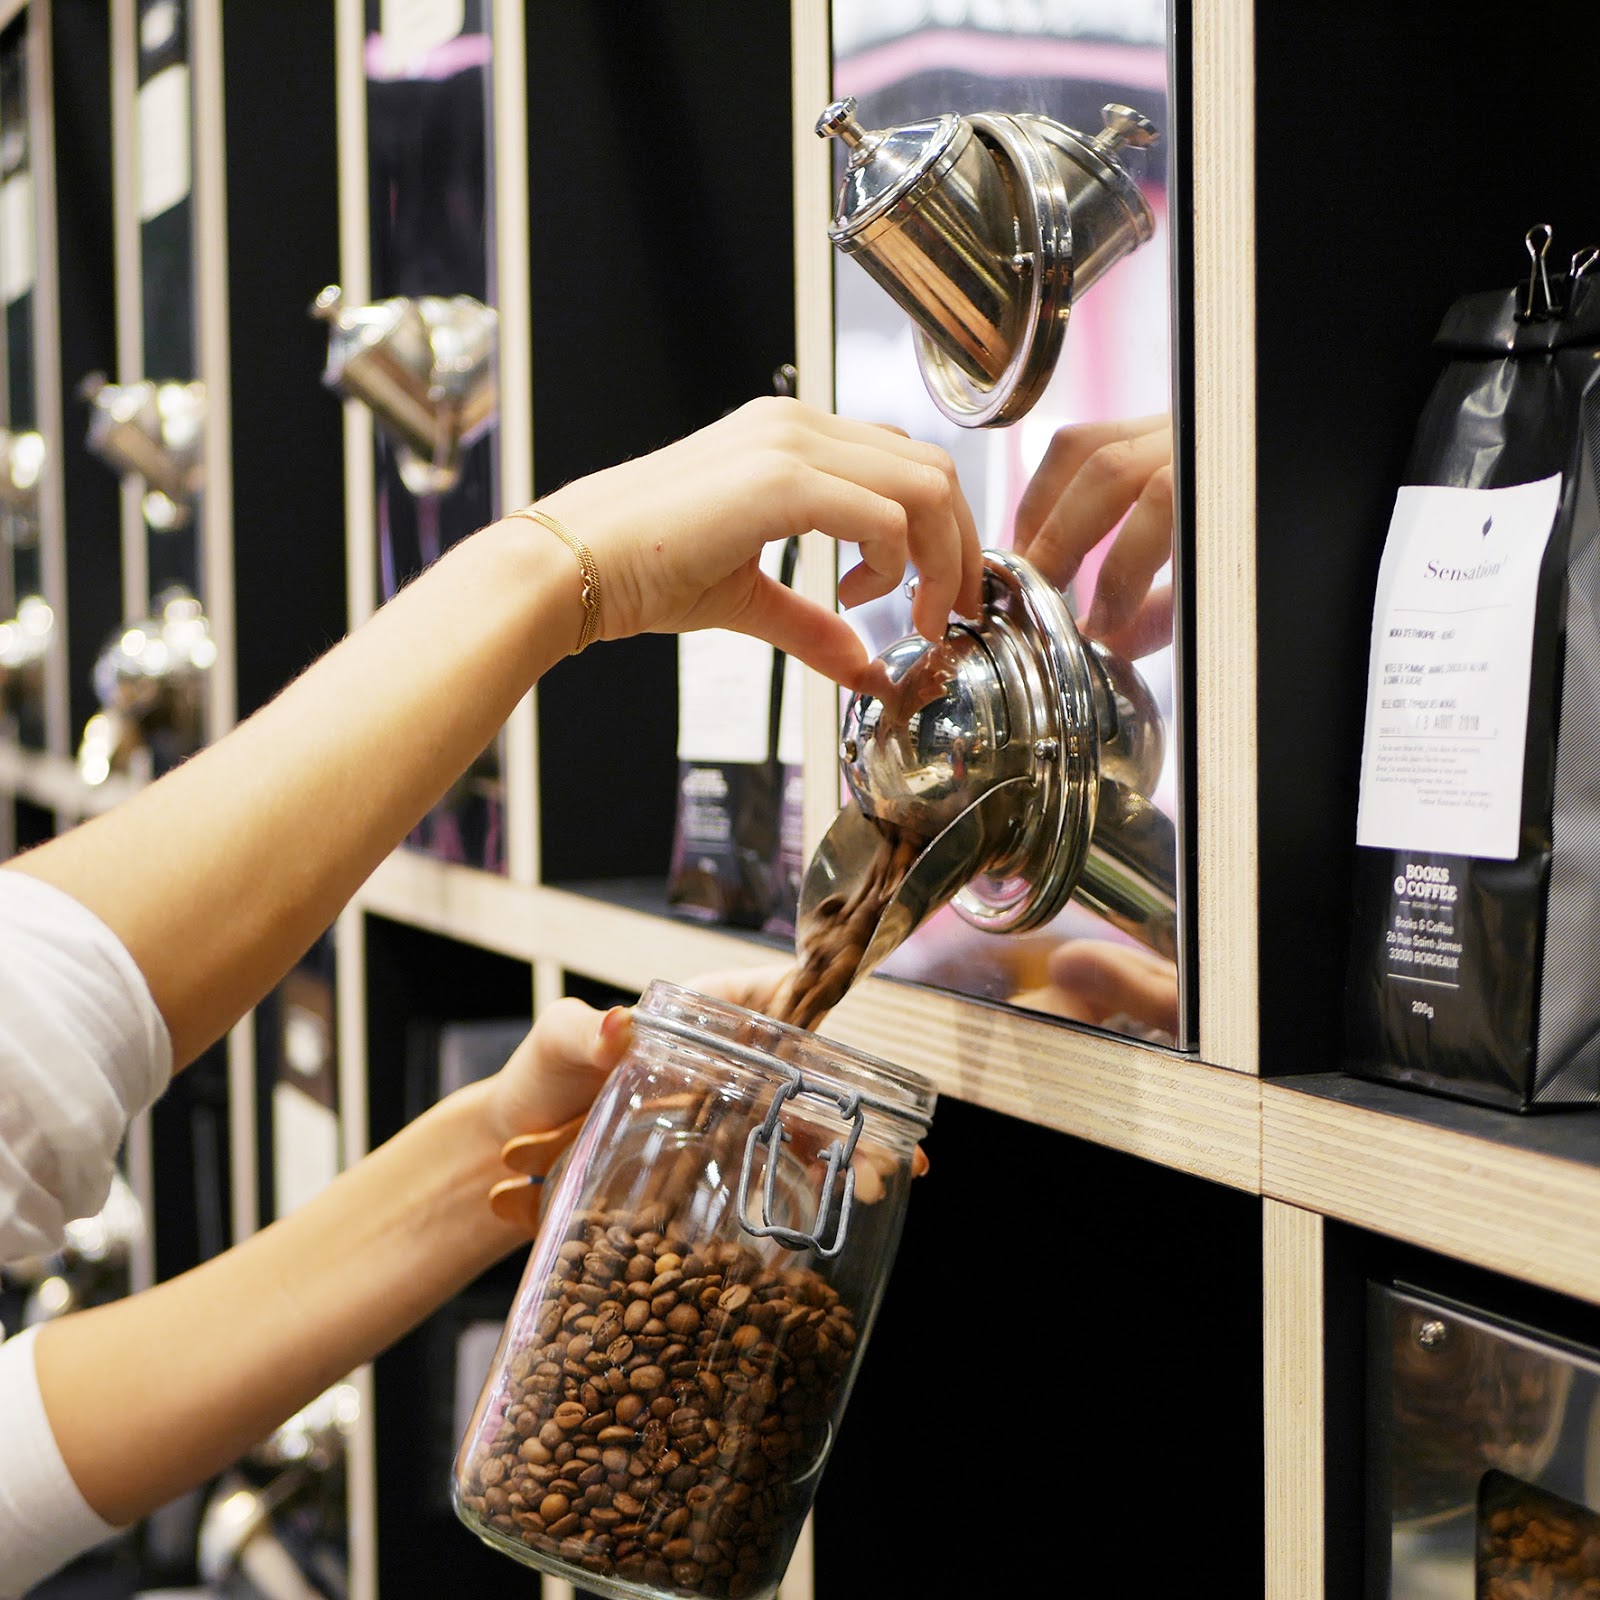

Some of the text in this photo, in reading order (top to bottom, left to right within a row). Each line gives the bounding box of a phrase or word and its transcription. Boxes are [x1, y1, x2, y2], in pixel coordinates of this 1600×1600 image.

[1405, 863, 1450, 884] BOOKS
[1406, 880, 1458, 901] COFFEE
[1394, 915, 1418, 930] Books
[1425, 919, 1454, 935] Coffee
[1397, 932, 1412, 945] Rue
[1388, 947, 1460, 969] 33000 BORDEAUX
[1411, 1000, 1435, 1019] 200g
